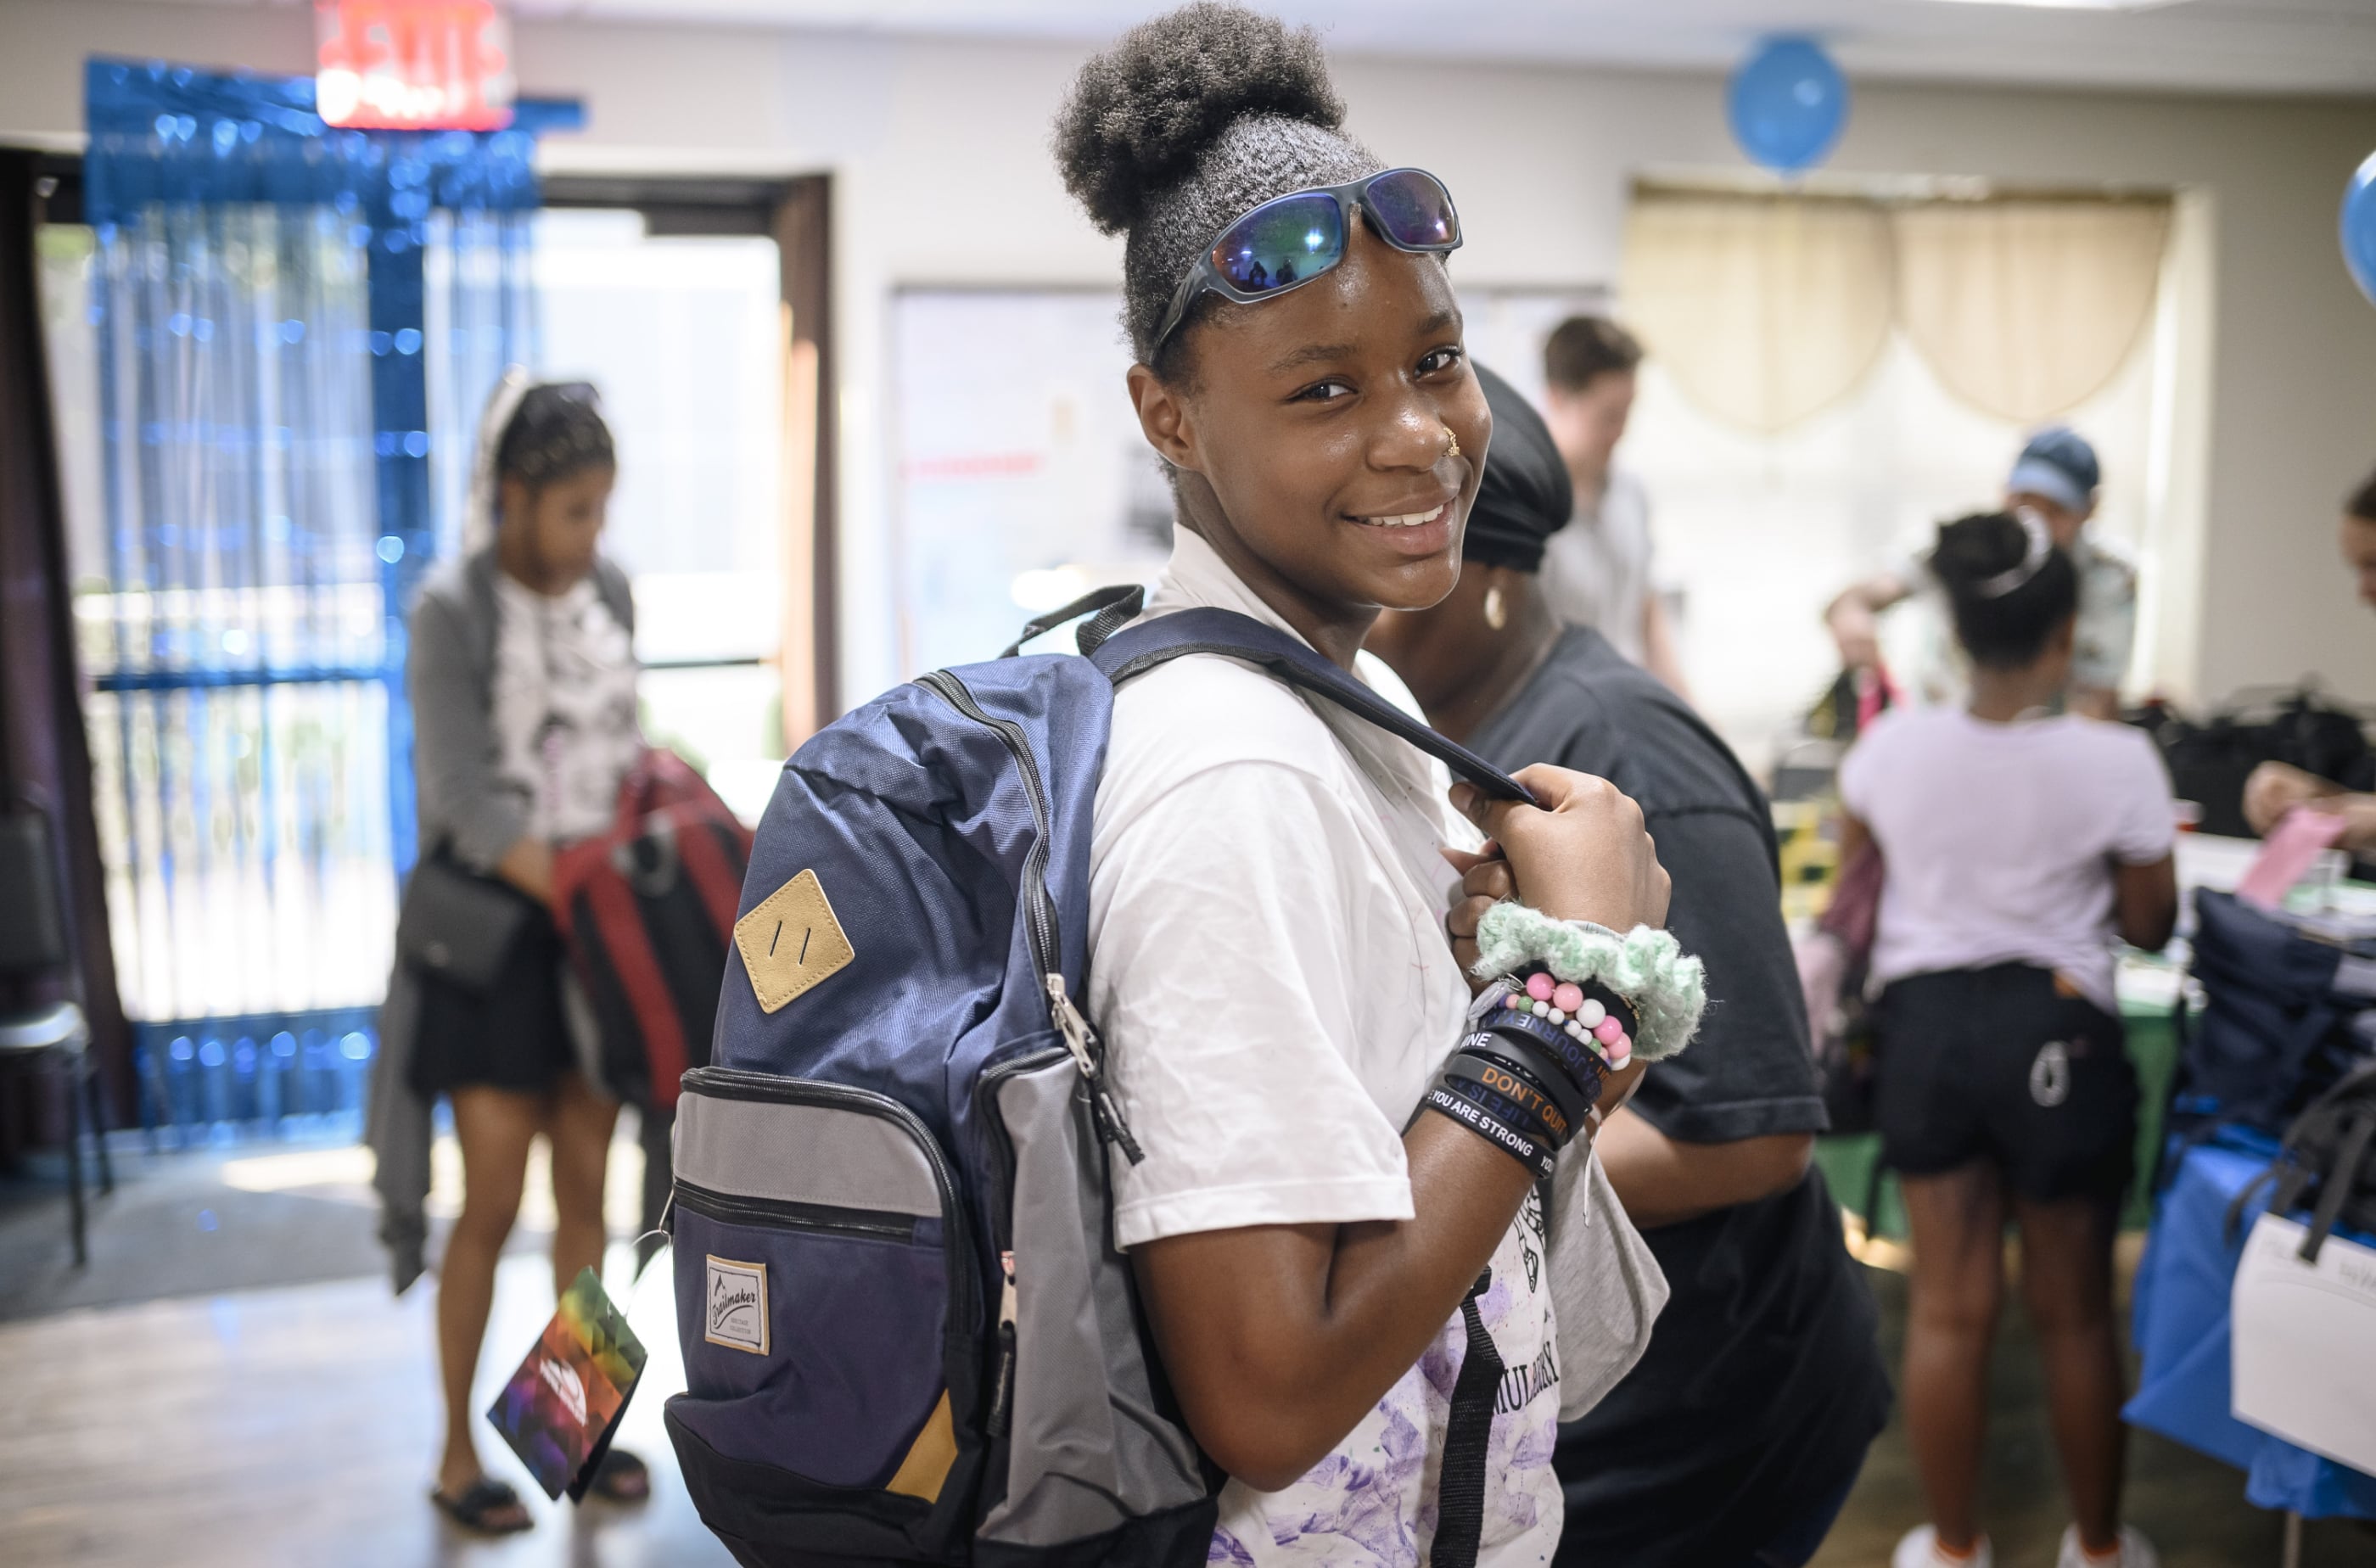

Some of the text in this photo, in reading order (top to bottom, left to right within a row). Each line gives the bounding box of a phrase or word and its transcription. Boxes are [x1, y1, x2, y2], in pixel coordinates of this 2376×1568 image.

[1432, 1089, 1454, 1106] YOU
[1450, 1100, 1480, 1123] ARE
[1479, 1117, 1533, 1156] STRONG
[1482, 1067, 1544, 1110] DON'T
[1542, 1105, 1567, 1136] QUIT
